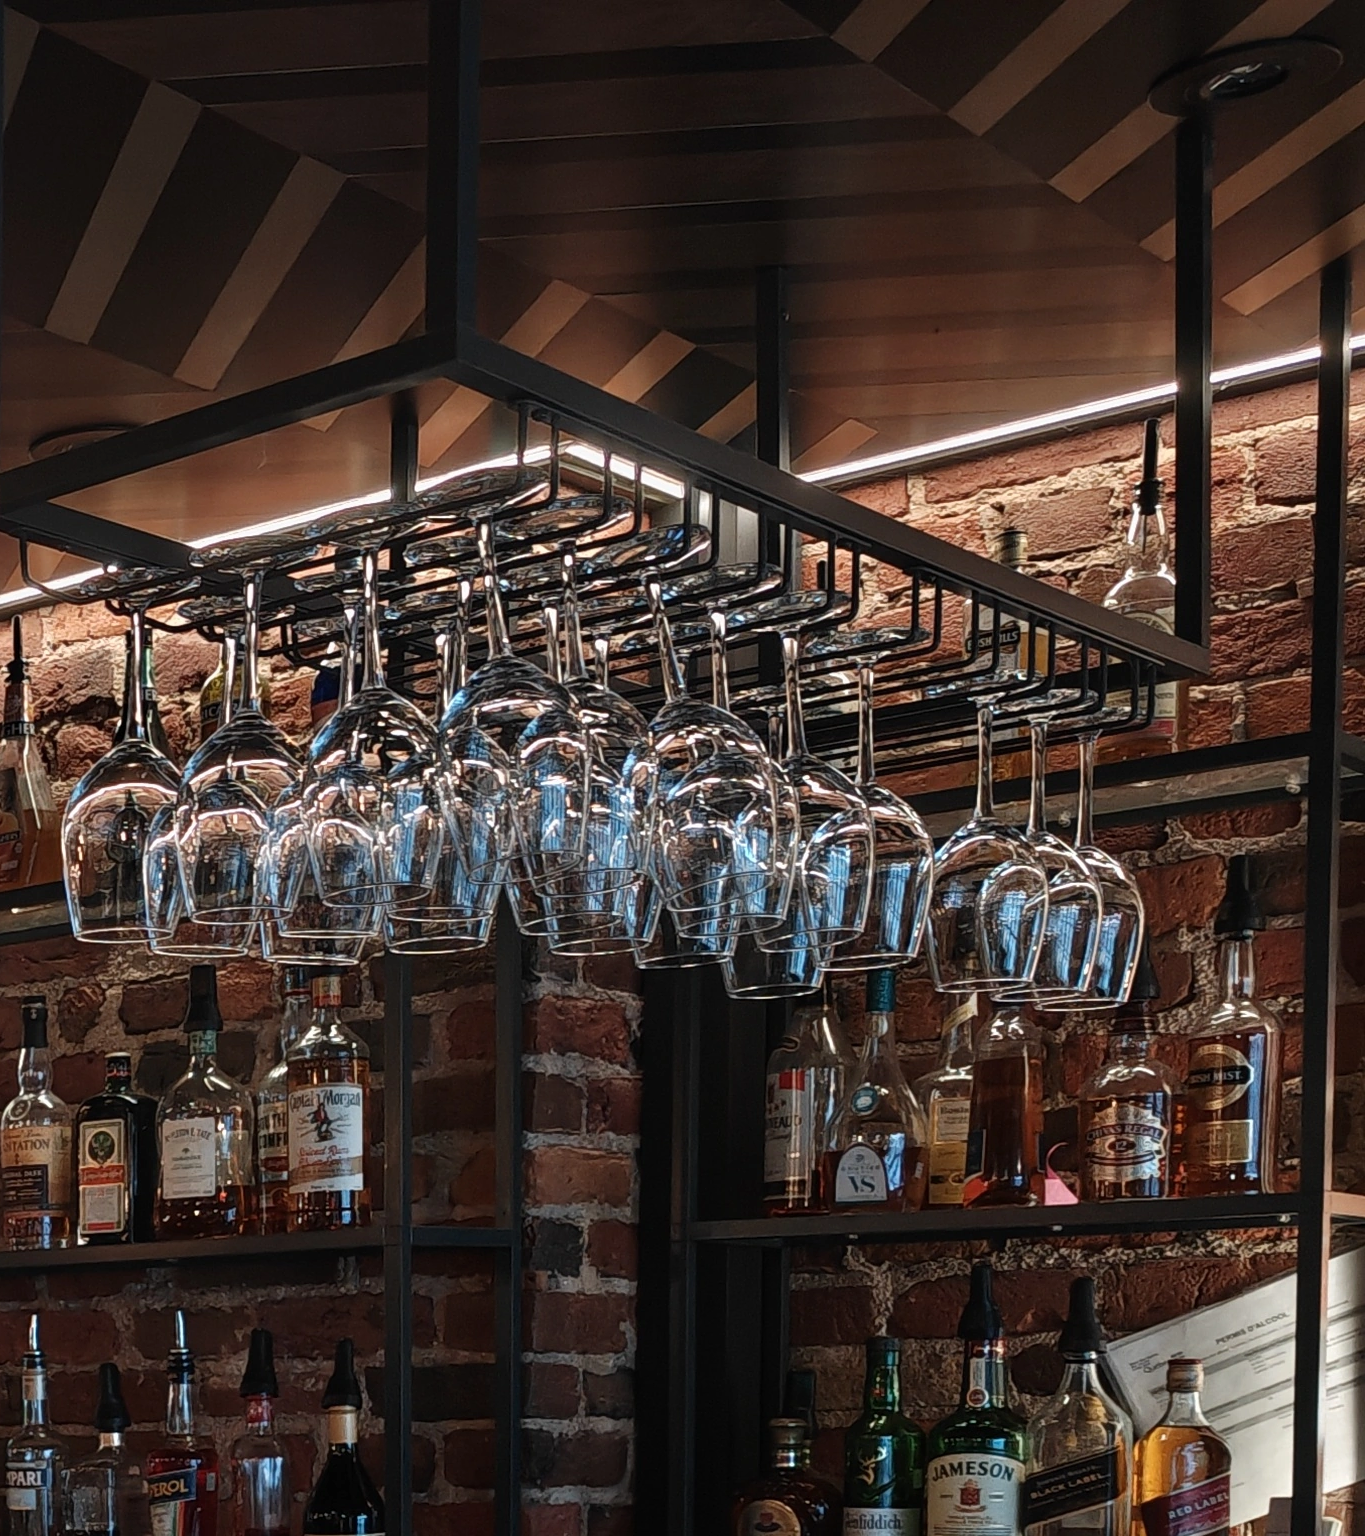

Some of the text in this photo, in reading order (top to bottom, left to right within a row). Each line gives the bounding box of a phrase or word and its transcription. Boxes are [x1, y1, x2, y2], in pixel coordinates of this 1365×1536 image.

[320, 1089, 361, 1108] Morgan
[1124, 1124, 1162, 1140] REGAL
[932, 1461, 1015, 1483] JAMESON
[1029, 1483, 1066, 1500] BLACK
[1067, 1473, 1104, 1490] LABEL
[1167, 1492, 1230, 1520] RED LABEL
